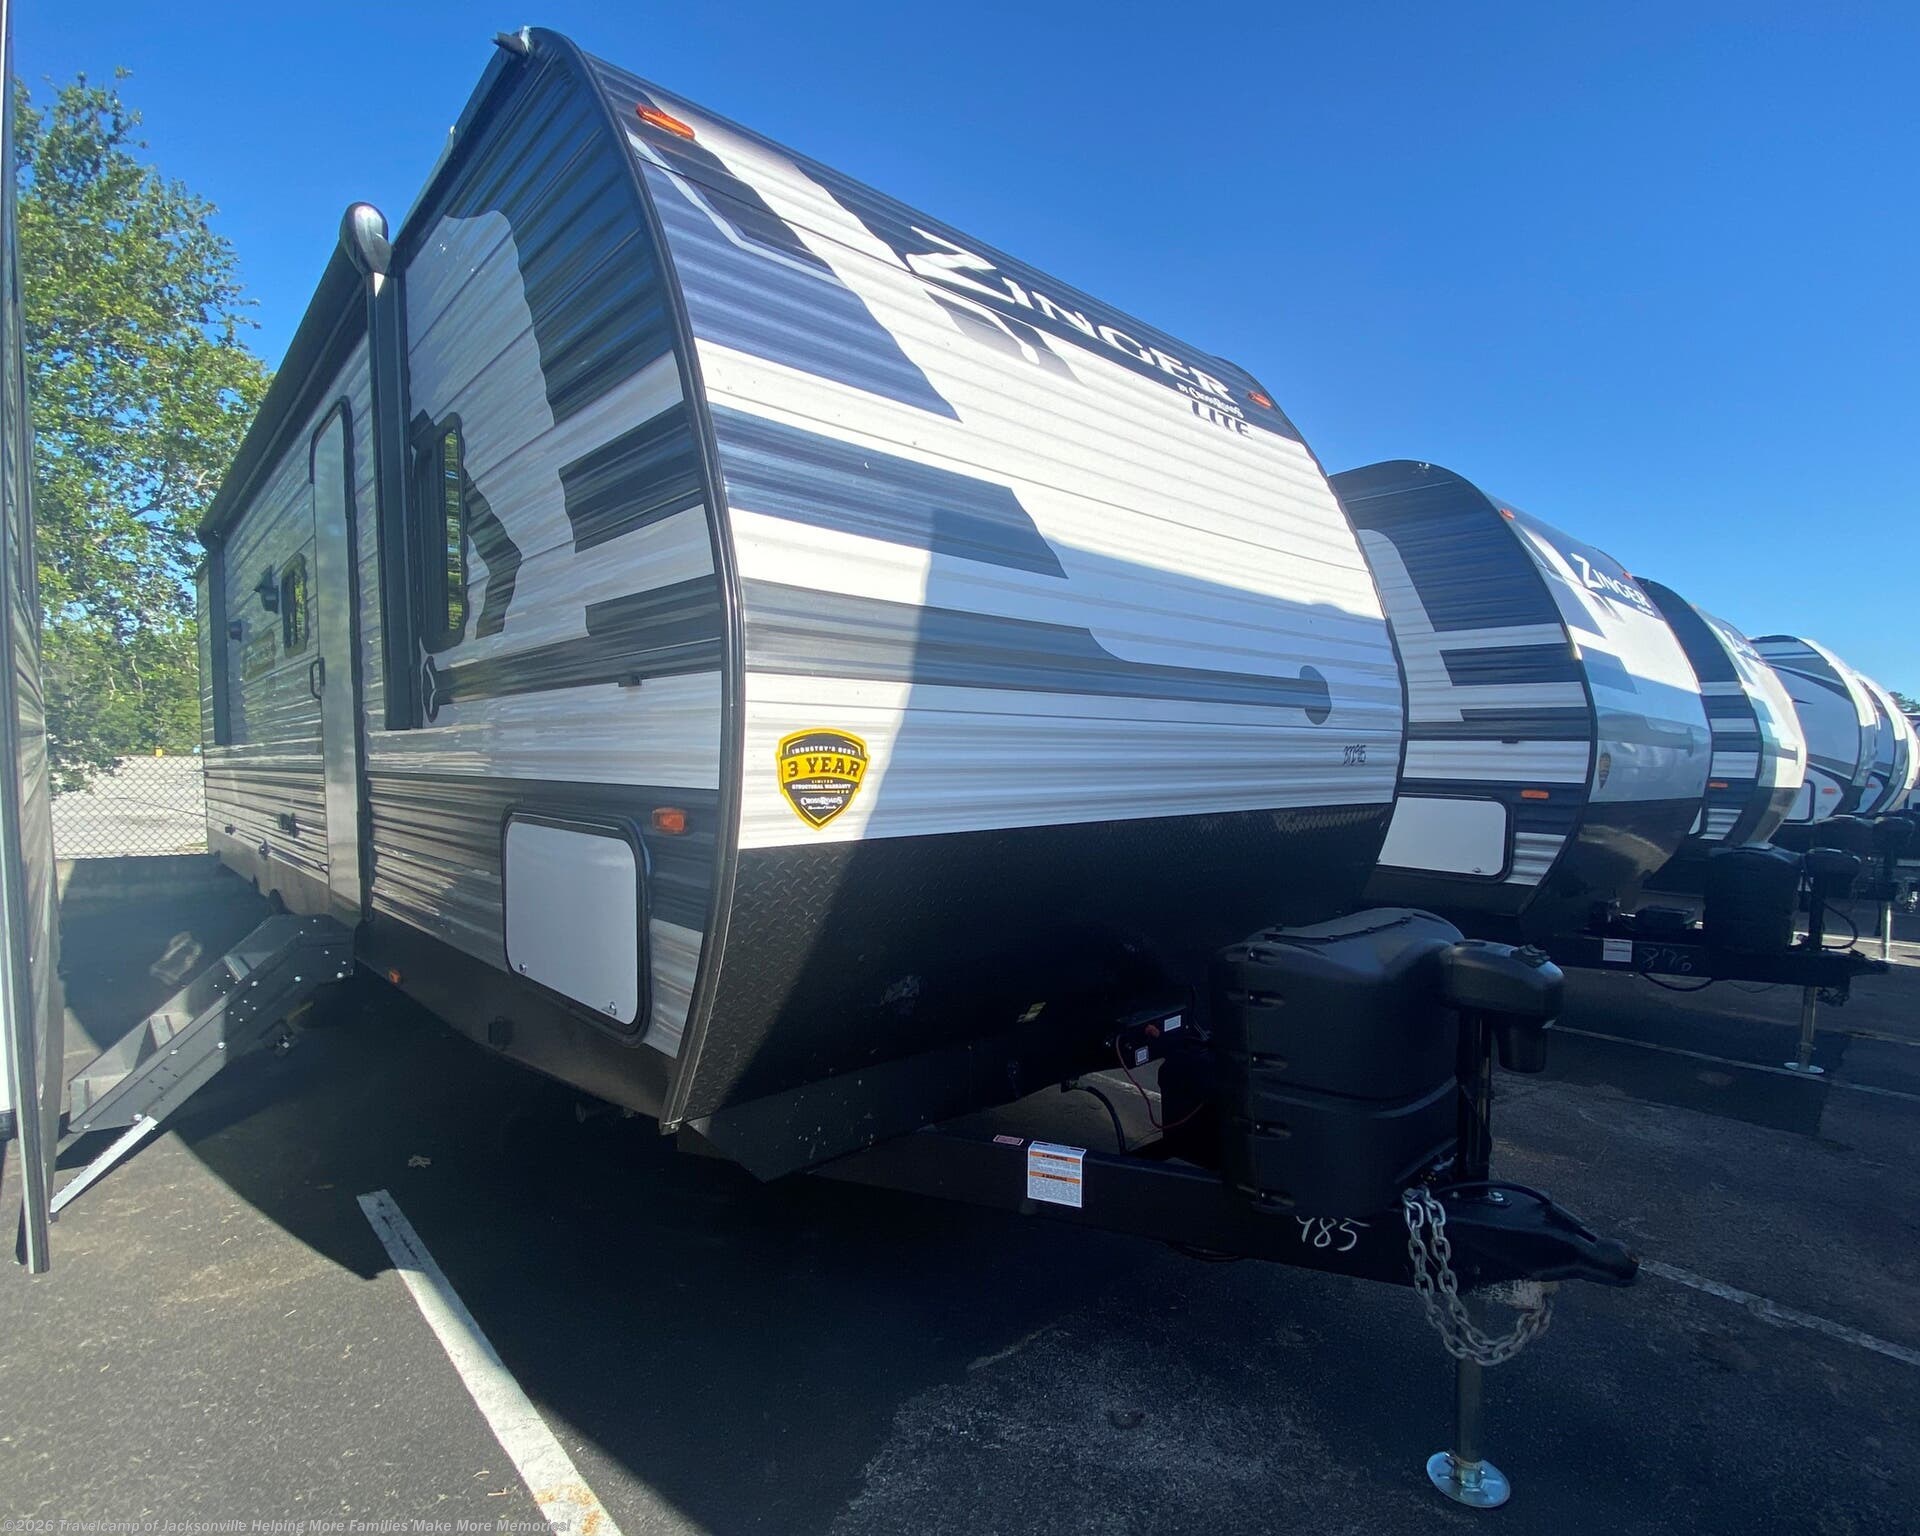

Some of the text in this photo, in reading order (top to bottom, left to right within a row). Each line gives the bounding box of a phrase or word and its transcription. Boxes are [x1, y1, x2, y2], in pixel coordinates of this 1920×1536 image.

[905, 226, 1239, 405] ZINGER
[1191, 400, 1254, 440] LITE
[1570, 552, 1652, 609] ZINGER
[788, 756, 861, 777] 3 YEAR
